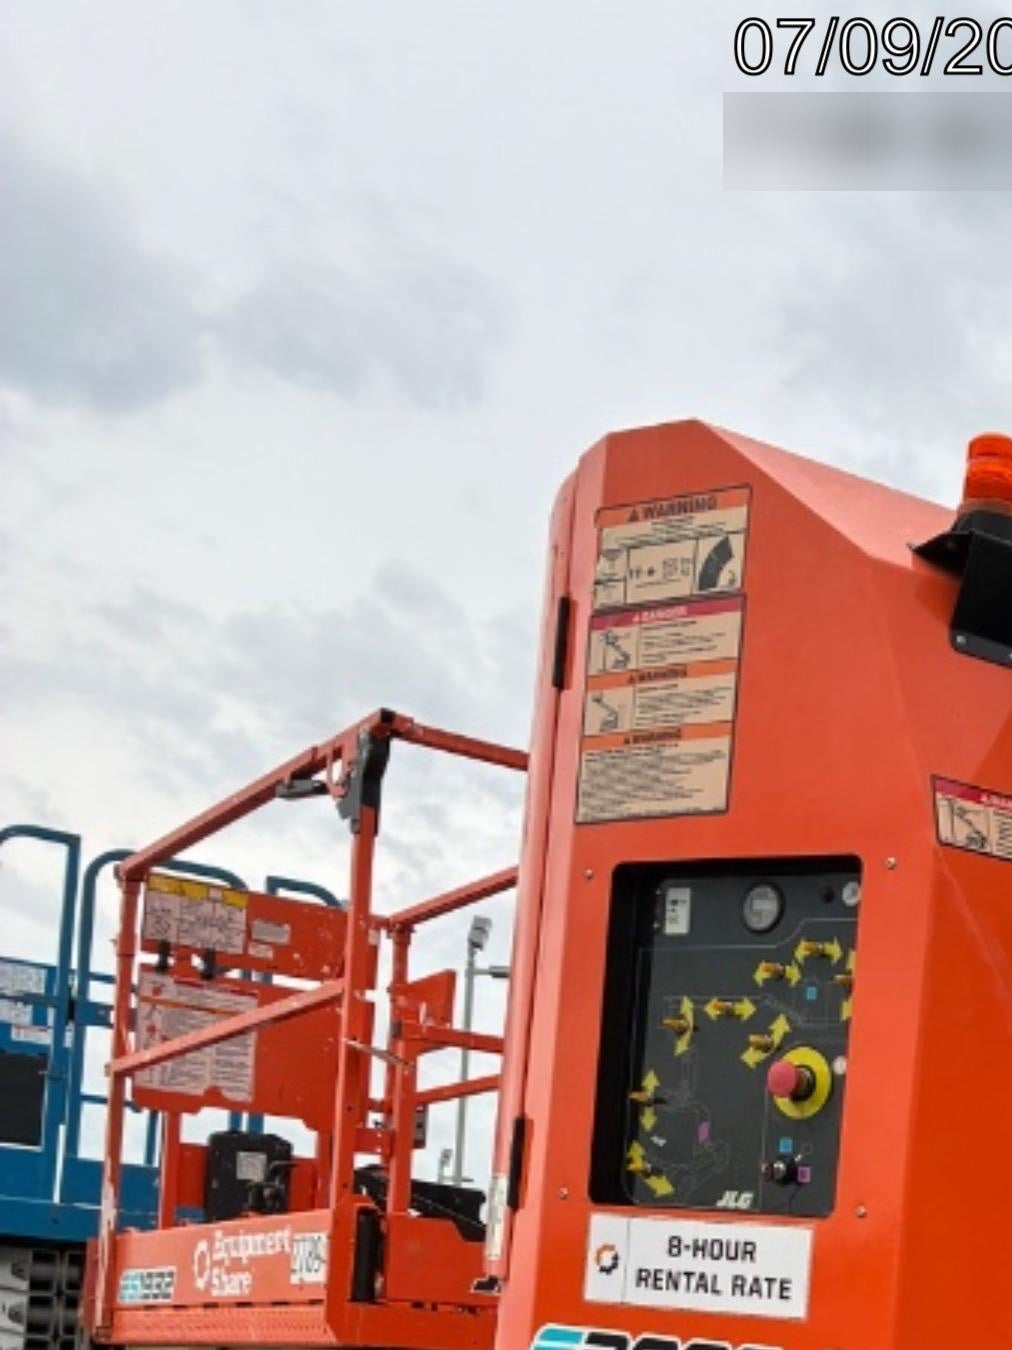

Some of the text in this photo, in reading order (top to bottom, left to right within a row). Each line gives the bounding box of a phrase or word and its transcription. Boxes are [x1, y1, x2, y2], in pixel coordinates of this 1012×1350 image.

[643, 495, 718, 519] WARNING
[716, 1189, 754, 1209] JLG
[212, 1226, 291, 1265] Equipment
[667, 1235, 757, 1262] 8-HOUR
[211, 1267, 253, 1296] Share
[635, 1268, 793, 1301] RENTAL RATE
